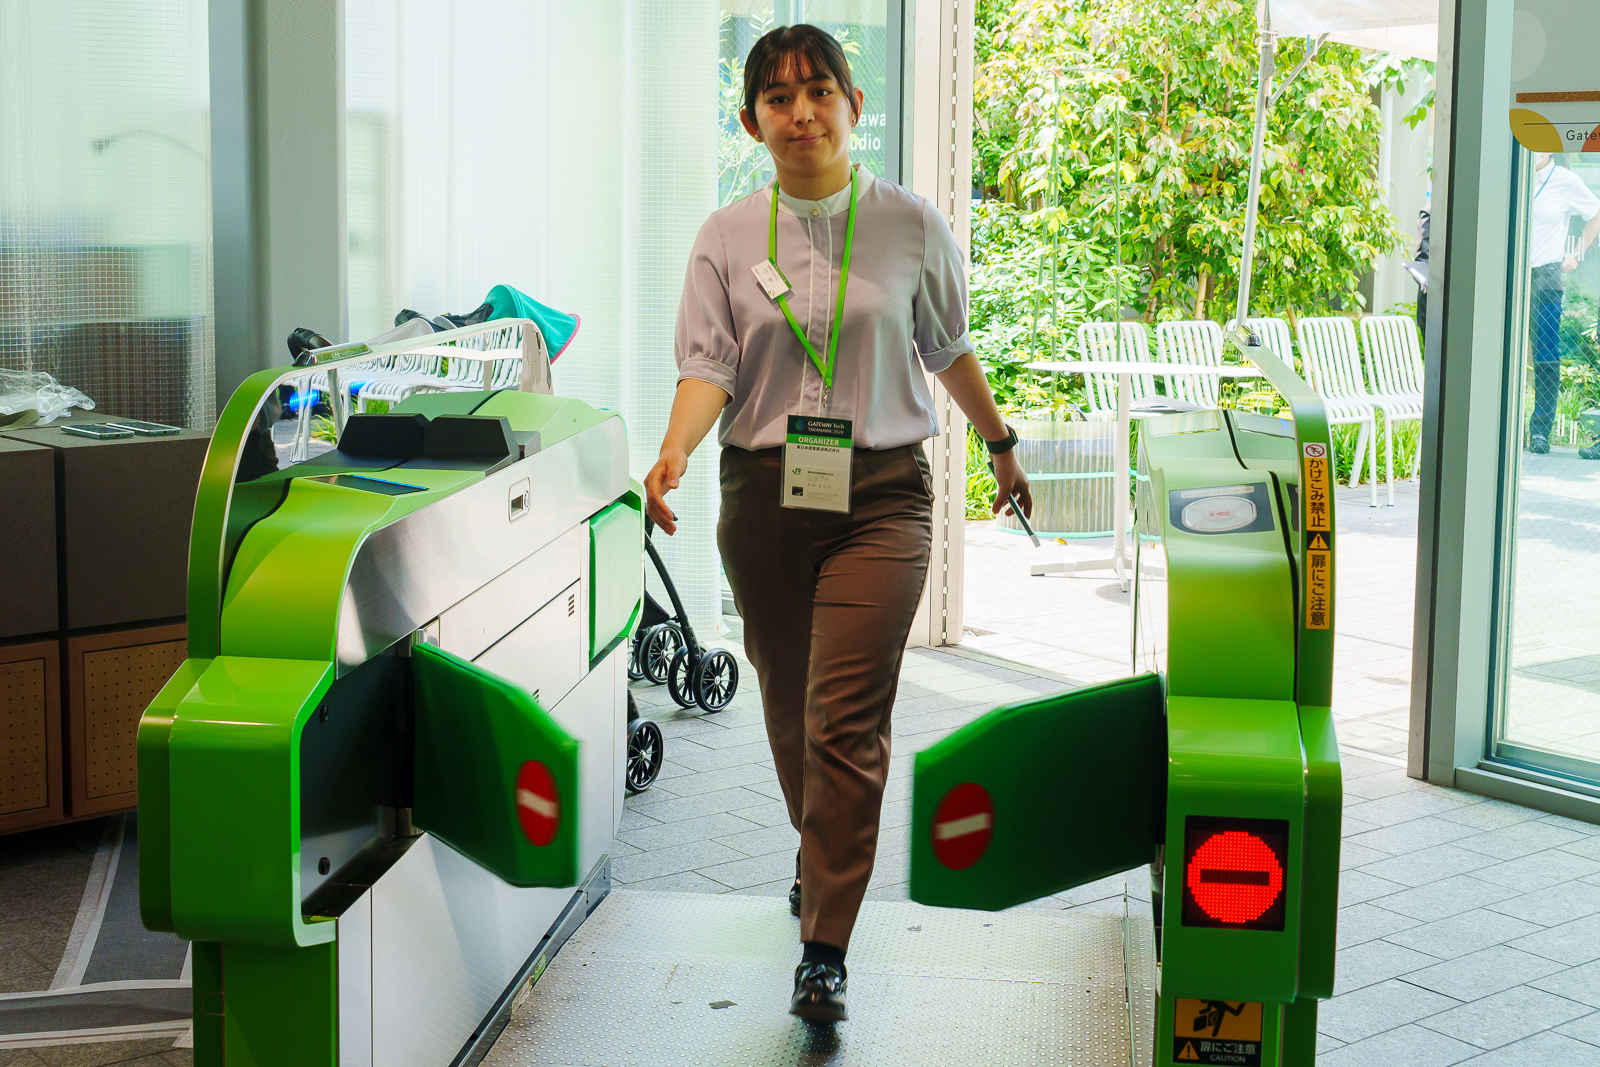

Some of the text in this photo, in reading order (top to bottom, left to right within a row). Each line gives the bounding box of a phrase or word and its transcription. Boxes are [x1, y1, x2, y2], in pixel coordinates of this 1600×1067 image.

[859, 113, 886, 127] ewa
[850, 133, 881, 151] udio
[807, 420, 845, 430] GATEWAY Tech
[798, 436, 840, 446] ORGANIZER
[1309, 458, 1326, 527] かけこみ禁止
[1310, 554, 1326, 626] 扉にご注意
[1200, 1041, 1256, 1055] 扉にご注意
[1210, 1054, 1246, 1063] CAUTION
